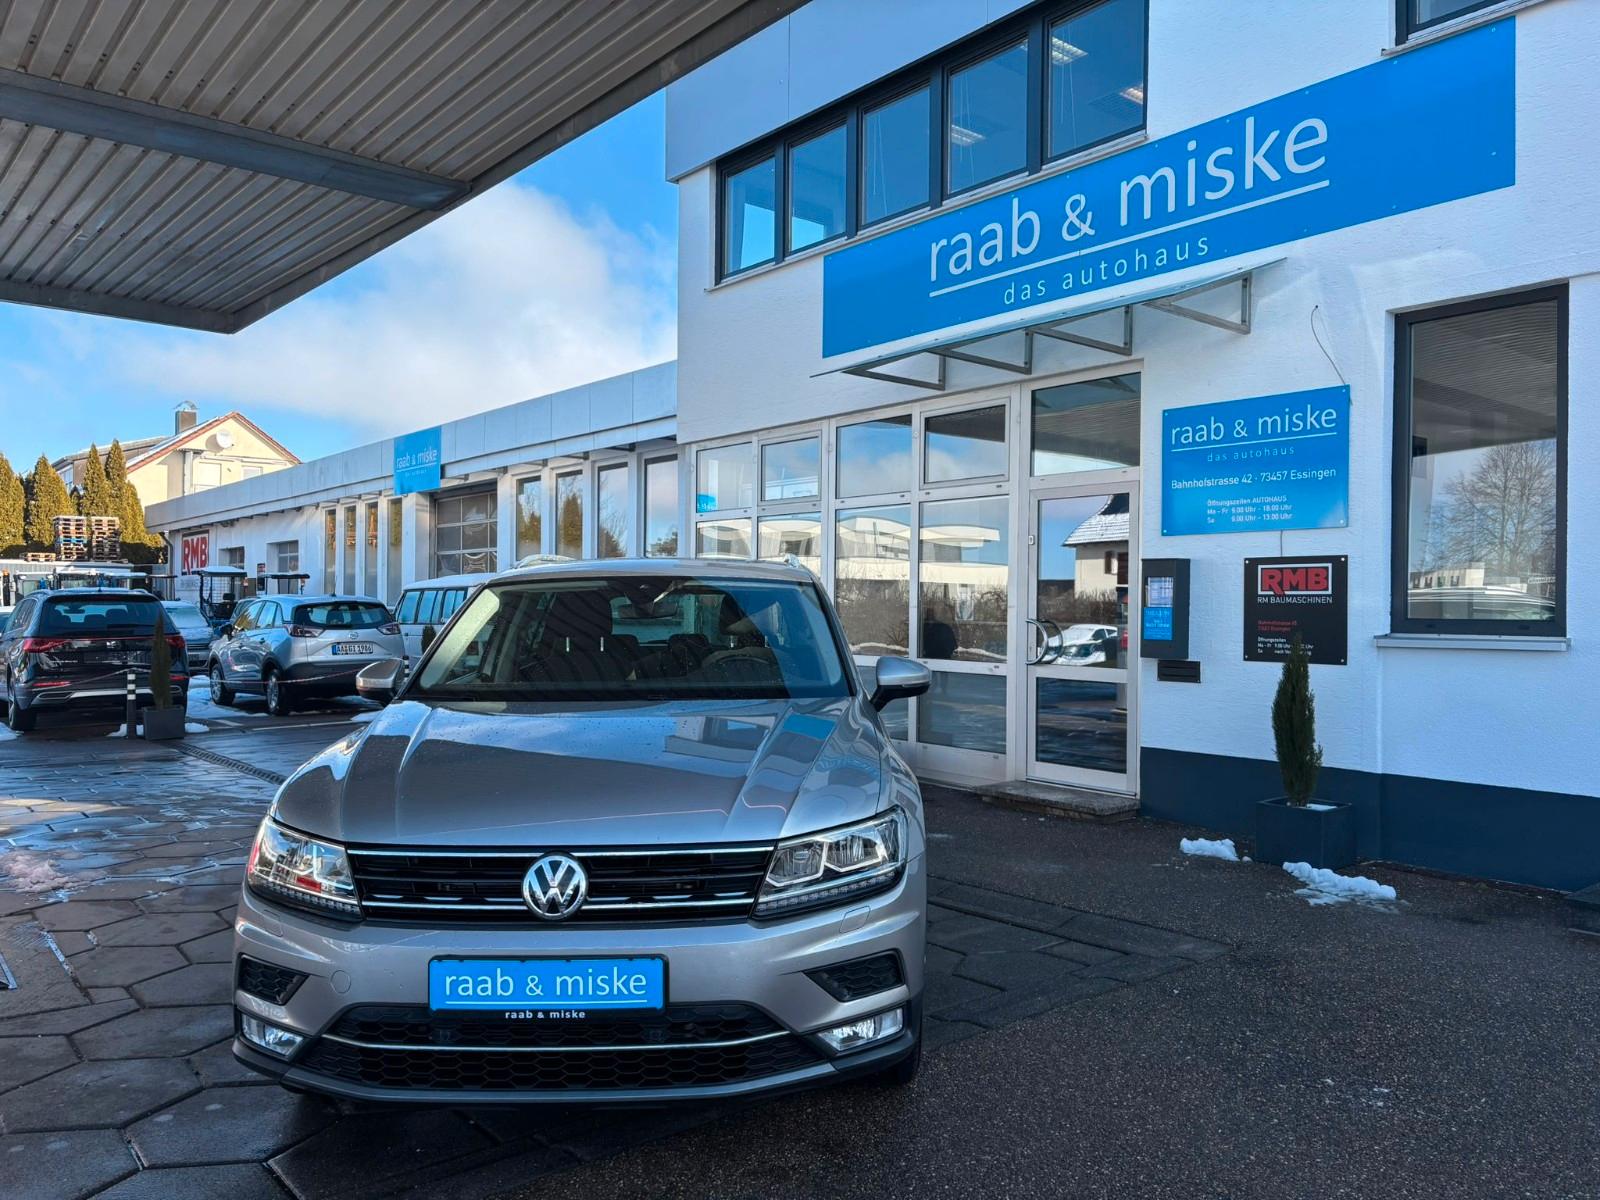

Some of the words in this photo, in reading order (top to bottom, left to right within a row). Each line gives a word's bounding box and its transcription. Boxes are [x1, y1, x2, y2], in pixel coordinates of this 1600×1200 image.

[930, 198, 1041, 282] raab
[1062, 193, 1096, 241] &
[1120, 116, 1328, 227] miske
[1004, 281, 1046, 305] das
[1062, 236, 1209, 289] autohaus
[1171, 416, 1224, 445] raab
[1233, 419, 1248, 438] &
[1258, 404, 1337, 435] miske
[1207, 452, 1227, 462] das
[1233, 446, 1295, 460] autohaus
[1171, 476, 1239, 489] Bahnhofstrasse
[1241, 474, 1252, 483] 42
[1260, 470, 1287, 482] 73457
[1290, 468, 1337, 481] Essingen
[1252, 495, 1287, 504] AUTOHAUS
[183, 536, 208, 575] RMB
[1262, 568, 1328, 595] RMB
[1257, 596, 1268, 604] RM
[1270, 596, 1333, 604] BAUMASCHINEN
[445, 968, 514, 996] raab
[525, 975, 544, 996] &
[556, 966, 647, 996] miske
[505, 1010, 533, 1019] raab
[537, 1010, 544, 1019] &
[550, 1010, 586, 1019] miske
